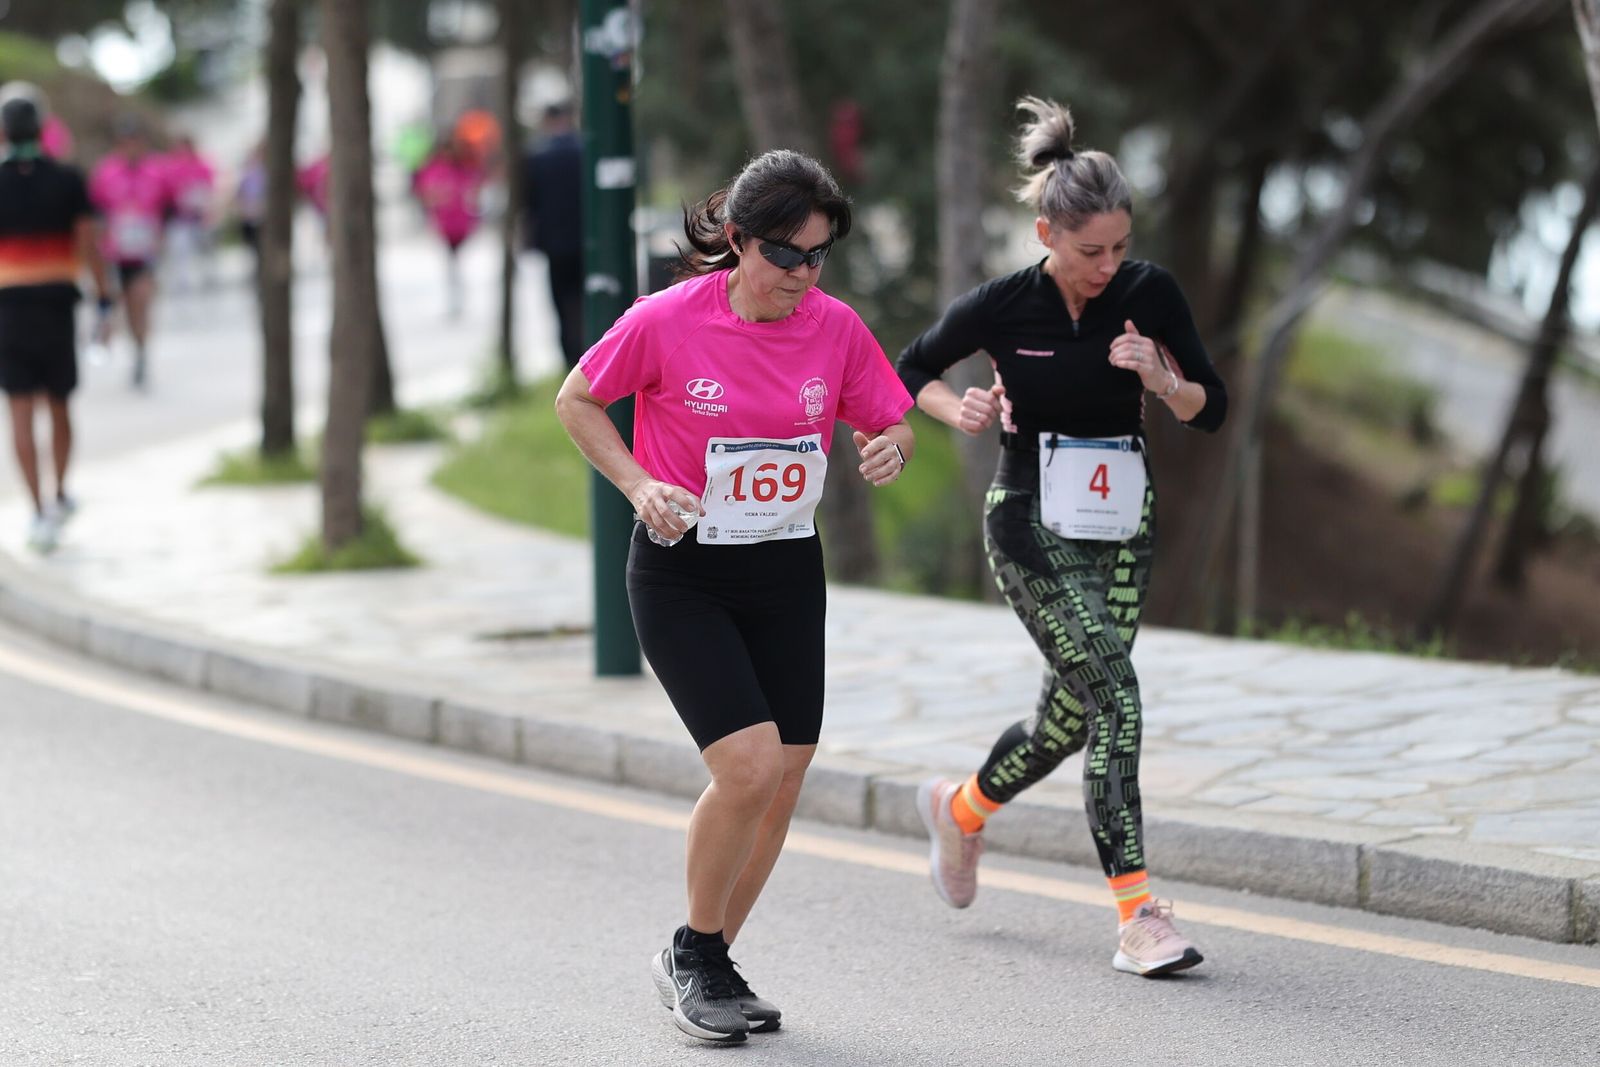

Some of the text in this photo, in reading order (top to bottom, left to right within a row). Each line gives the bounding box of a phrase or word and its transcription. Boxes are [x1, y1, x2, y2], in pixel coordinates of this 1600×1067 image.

[684, 399, 728, 413] HYUNDAI
[724, 463, 806, 503] 169
[1089, 463, 1110, 500] 4
